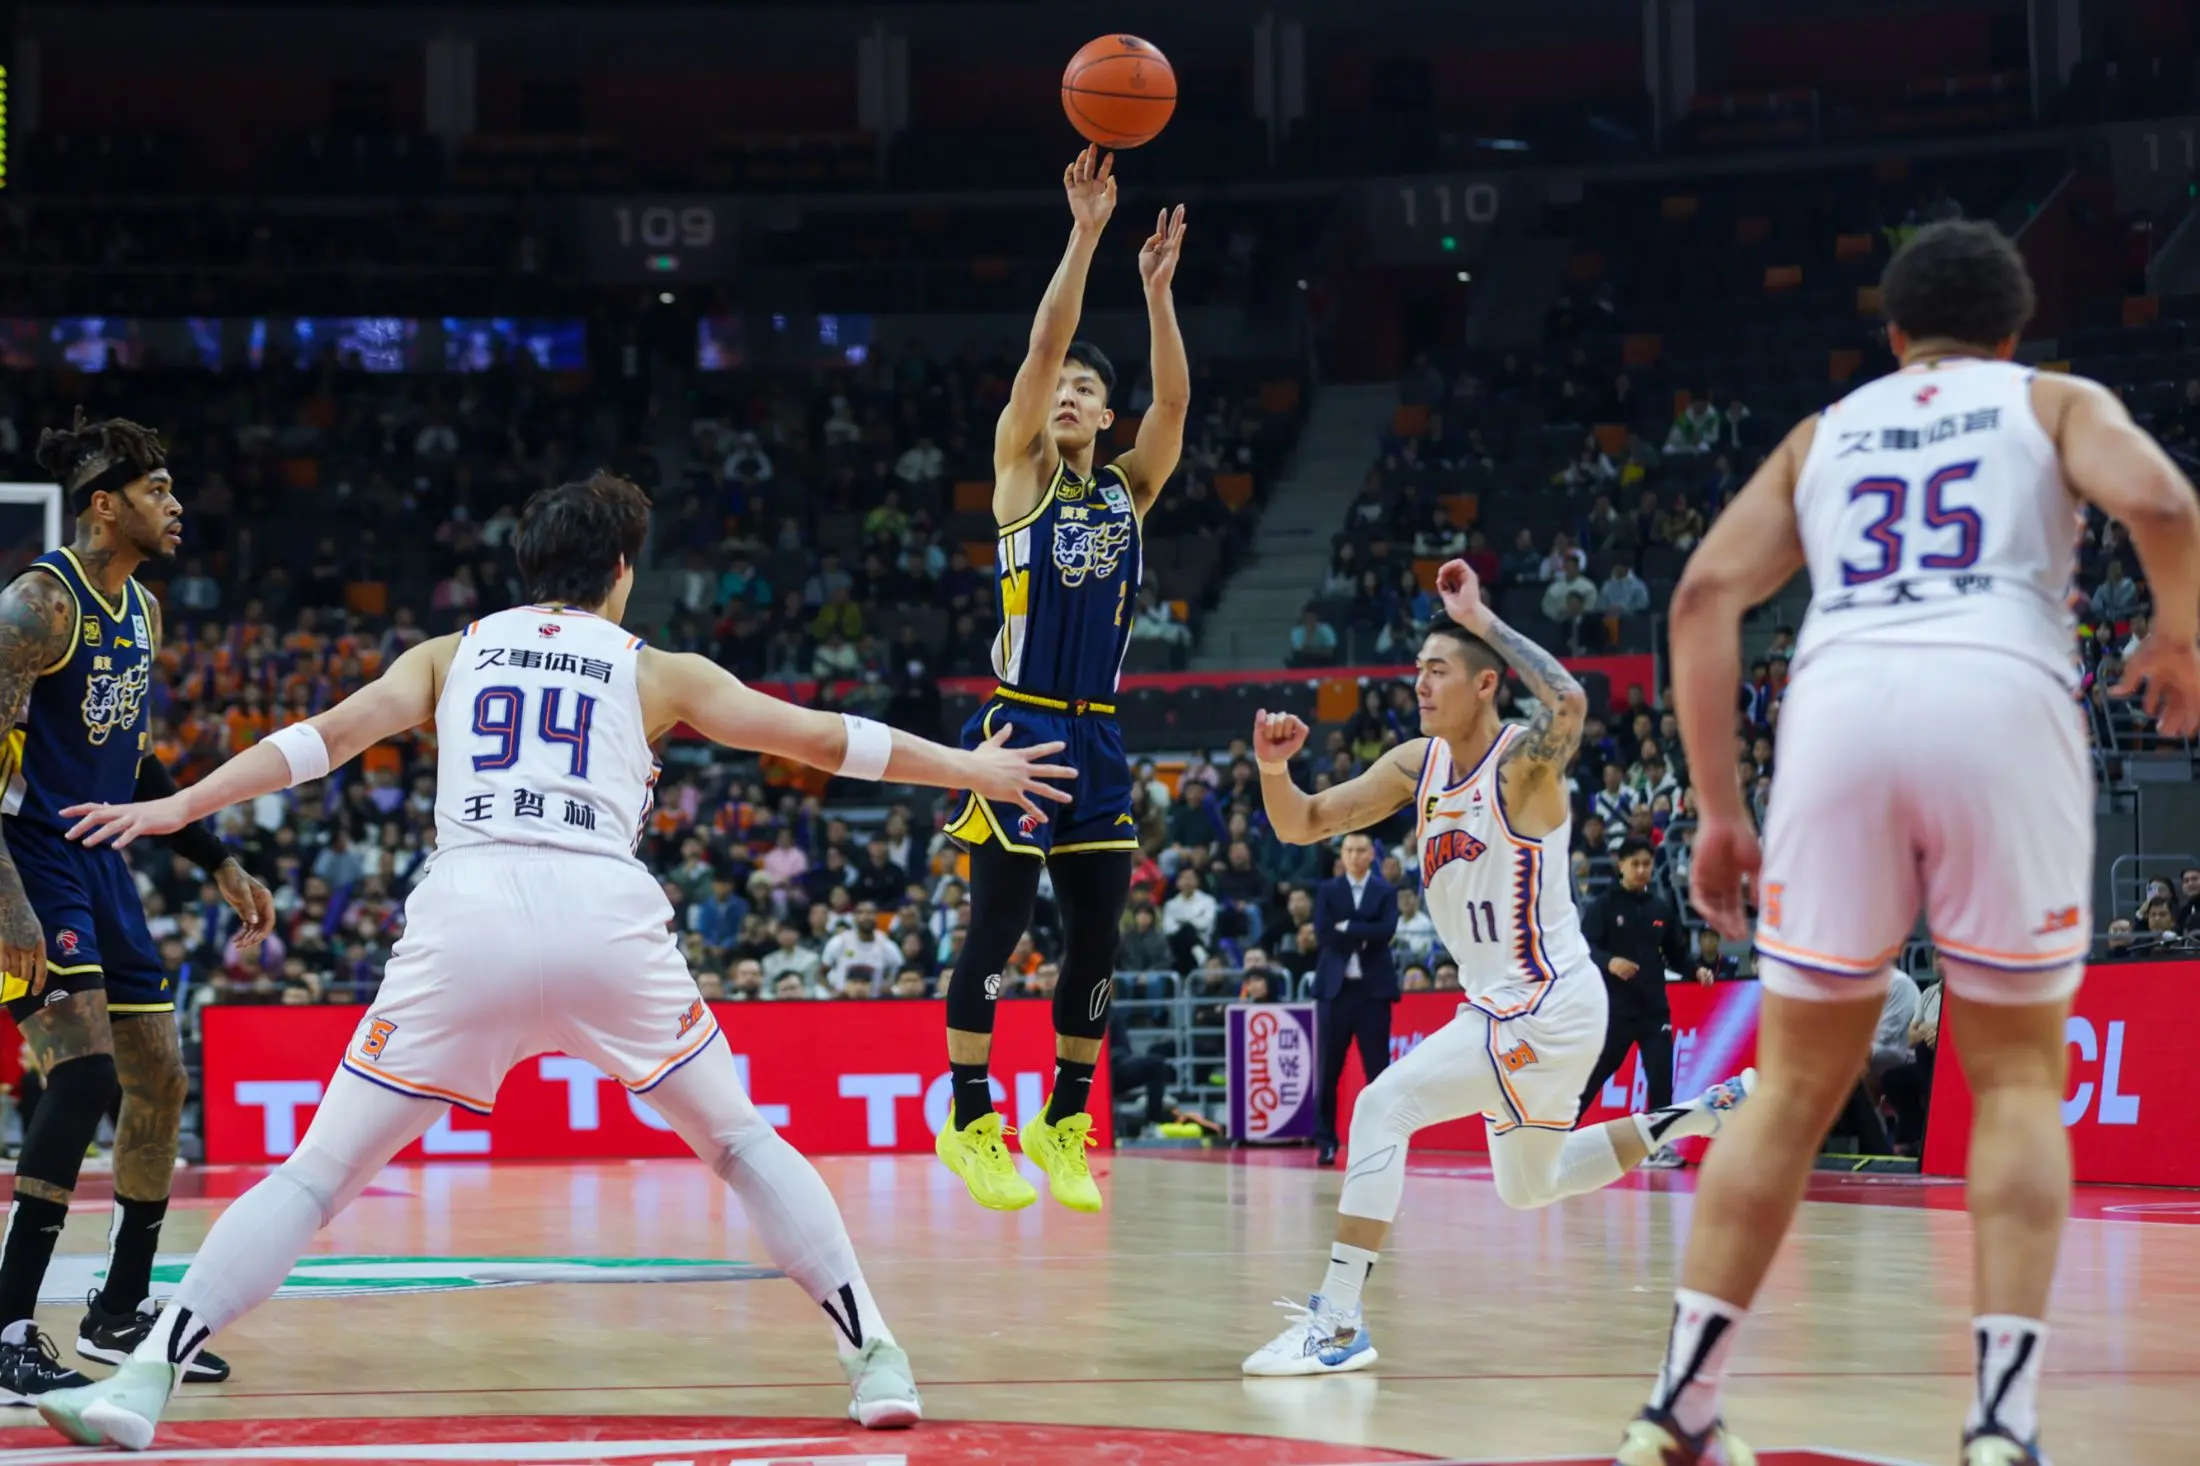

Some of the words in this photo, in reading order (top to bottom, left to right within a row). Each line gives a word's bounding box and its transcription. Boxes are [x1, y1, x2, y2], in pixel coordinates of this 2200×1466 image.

[614, 207, 714, 246] 109
[1401, 184, 1498, 226] 110
[1841, 459, 1983, 586] 35
[475, 648, 614, 684] 久事体育
[472, 686, 598, 779] 94
[462, 788, 597, 831] 王哲林
[1467, 901, 1499, 942] 11
[1278, 1029, 1299, 1106] 百岁山
[2061, 1016, 2141, 1126] CL
[235, 1081, 491, 1156] TL
